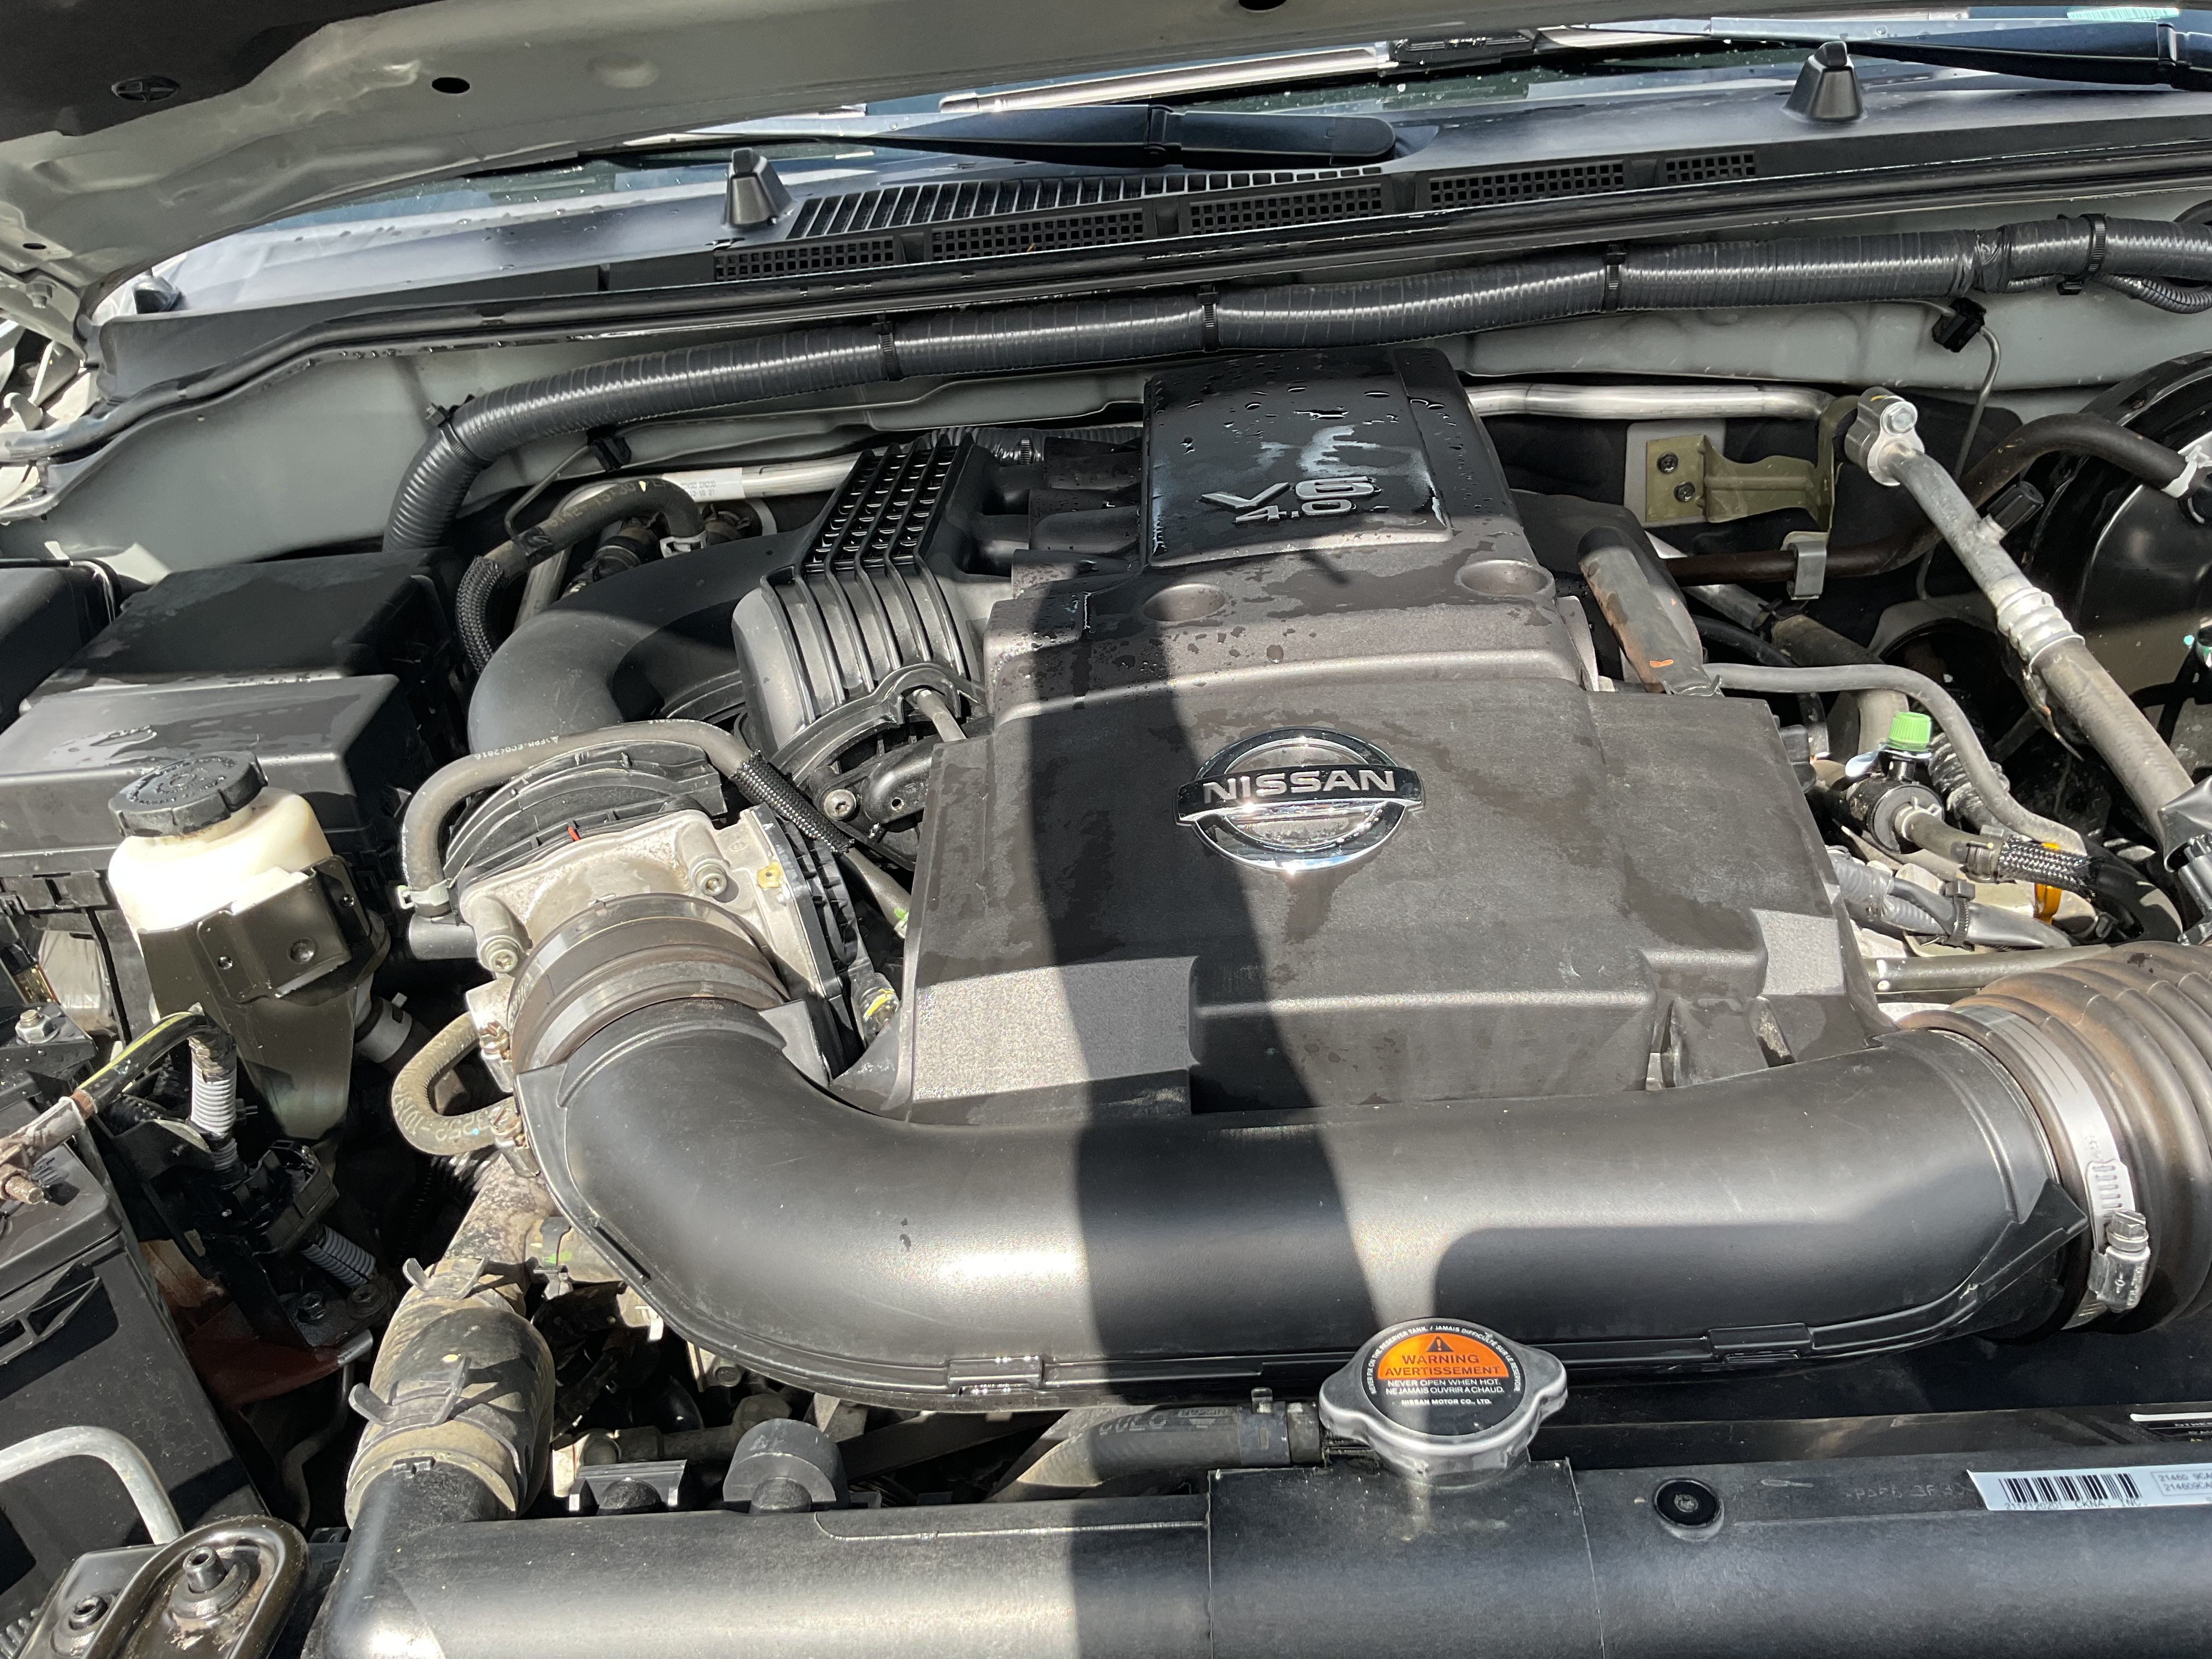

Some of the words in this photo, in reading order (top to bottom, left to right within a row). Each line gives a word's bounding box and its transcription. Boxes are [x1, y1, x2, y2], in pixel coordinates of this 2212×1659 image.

[1199, 476, 1375, 509] V6
[1235, 499, 1356, 524] 4.0
[1203, 770, 1396, 804] NISSAN
[1379, 1331, 1408, 1350] RESERVER
[1372, 1348, 1383, 1359] THE
[1495, 1345, 1508, 1356] SUR
[1368, 1358, 1376, 1367] ON
[1402, 1354, 1479, 1364] WARNING
[1505, 1355, 1514, 1363] LE
[1385, 1366, 1500, 1376] AVERTISSEMENT
[1367, 1376, 1378, 1394] NEVER
[2164, 1481, 2212, 1491] 214609CA
